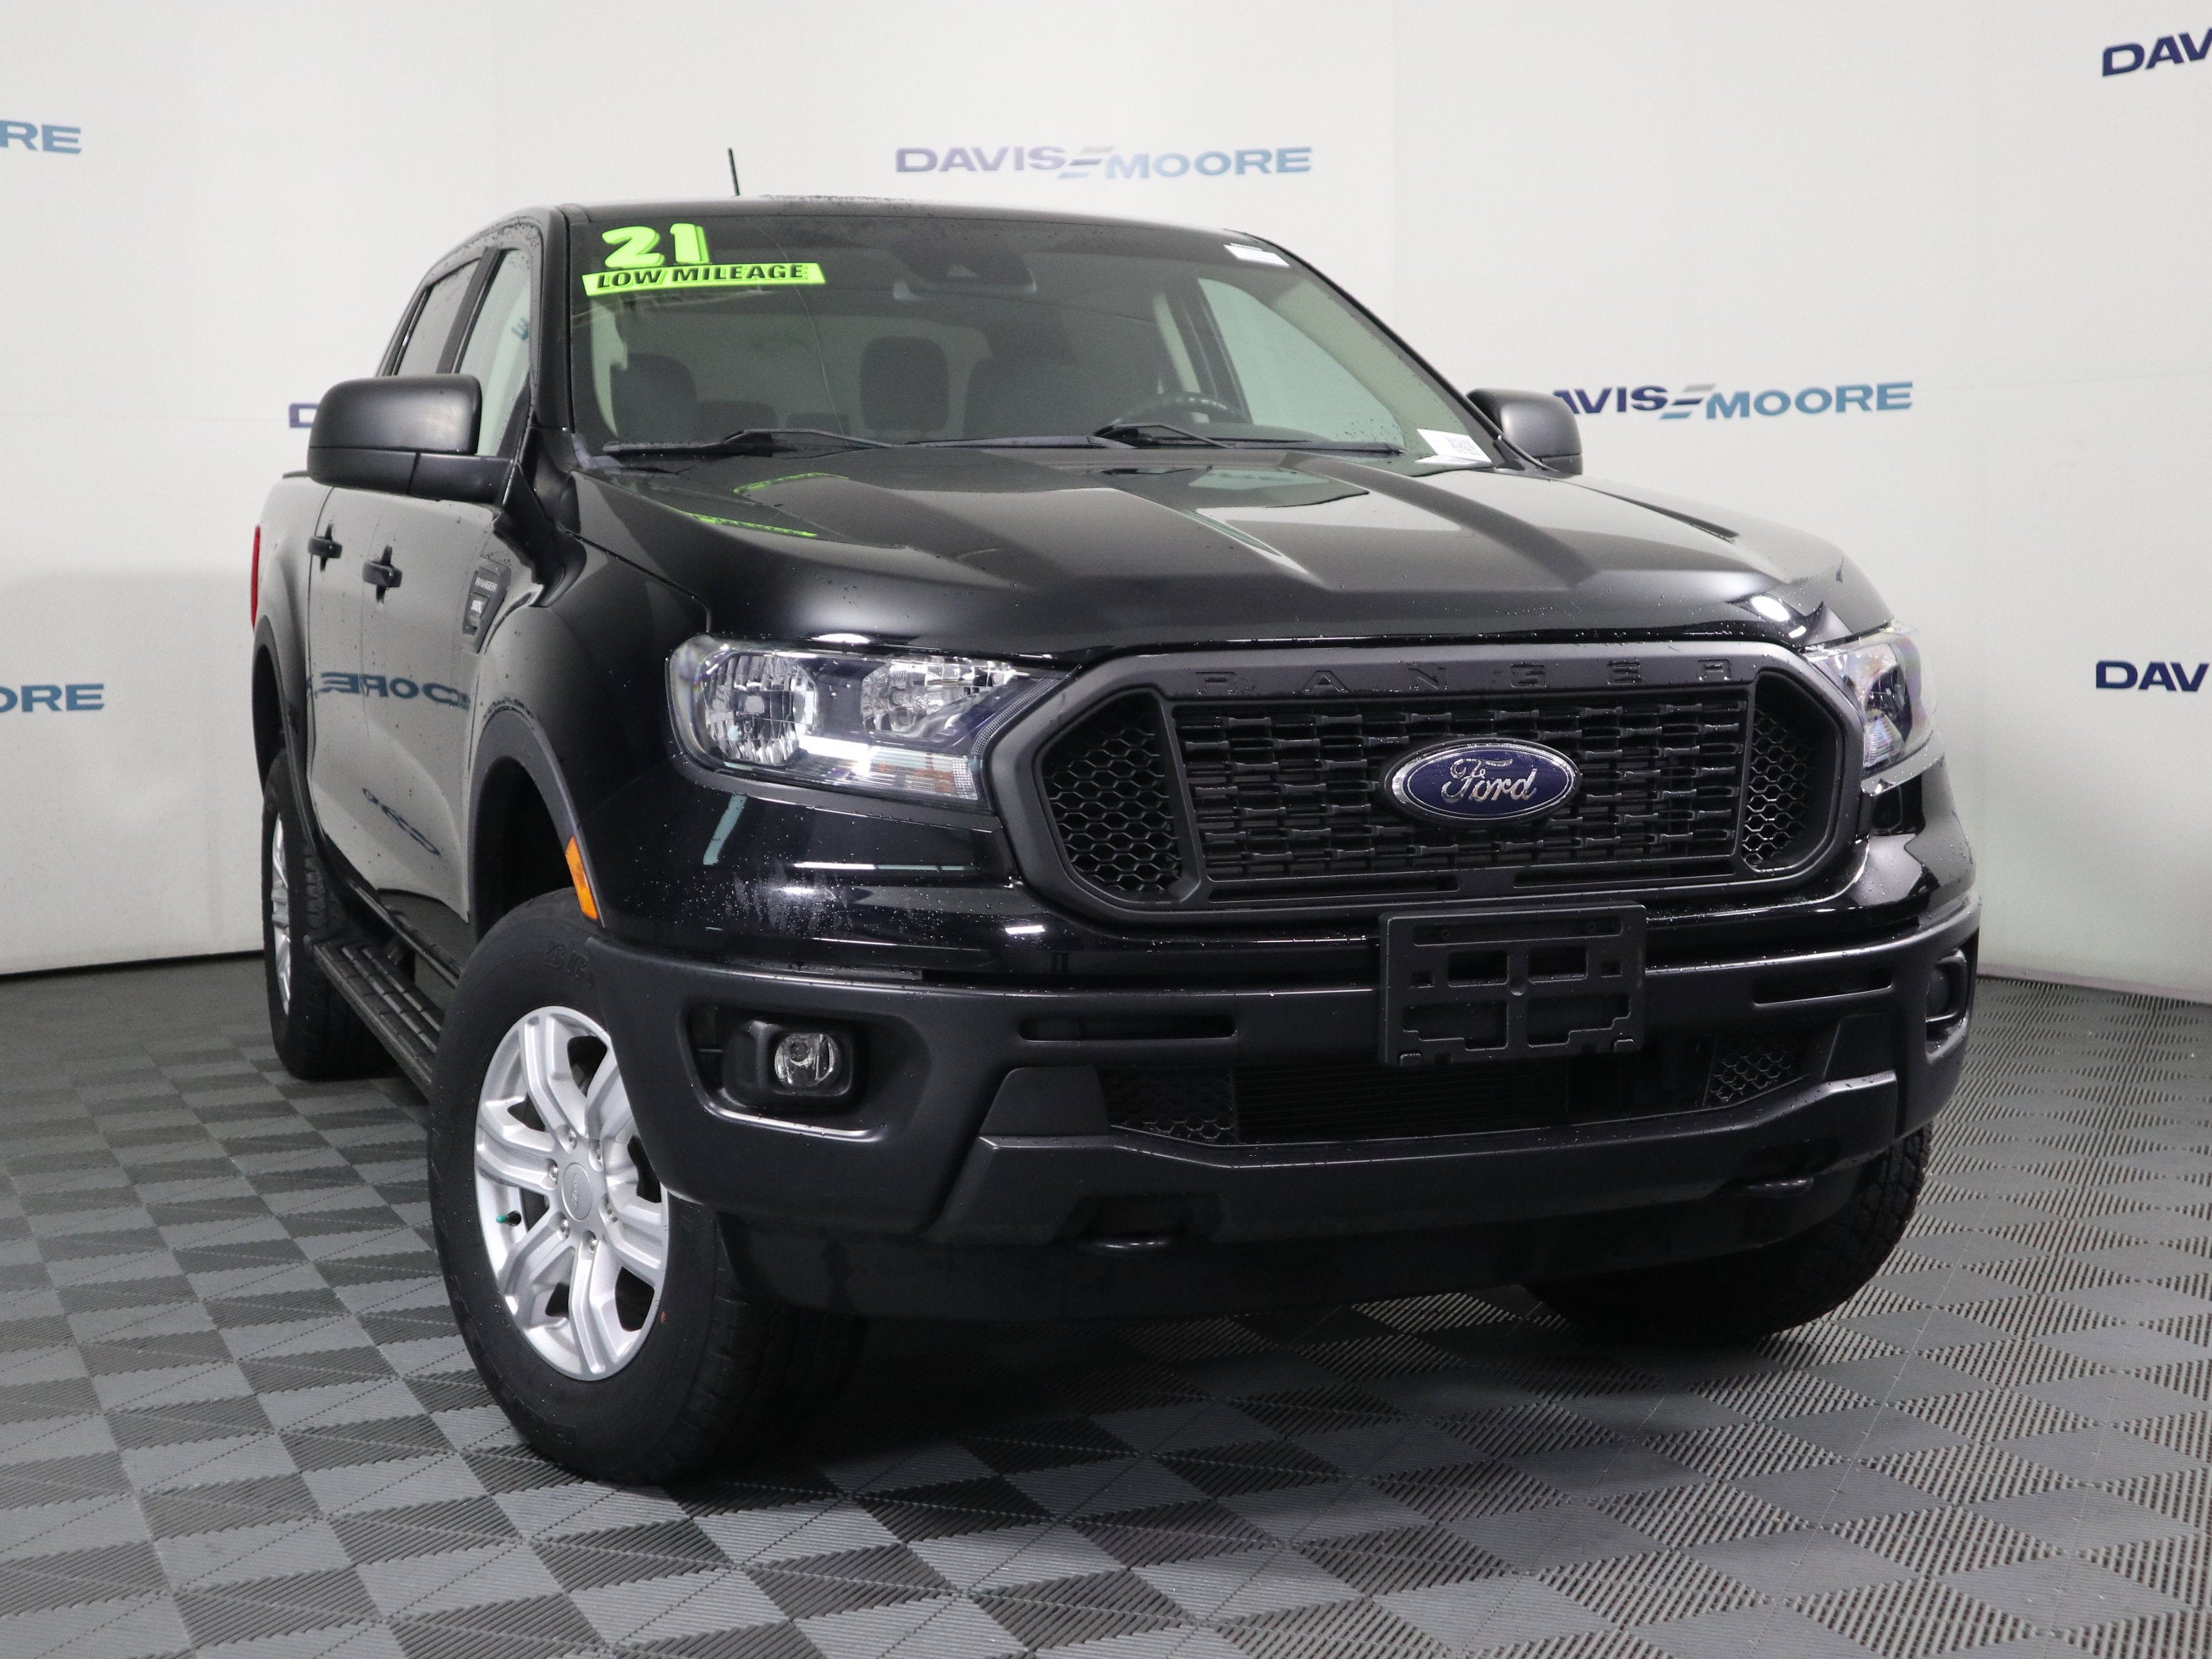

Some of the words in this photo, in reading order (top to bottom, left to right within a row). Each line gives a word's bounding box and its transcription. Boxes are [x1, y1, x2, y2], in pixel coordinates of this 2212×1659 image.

[2102, 27, 2212, 77] DAV
[896, 145, 1067, 172] DAVIS
[1104, 146, 1312, 179] MOORE
[601, 222, 710, 269] 21
[596, 269, 665, 290] LOW
[670, 263, 806, 282] MILEAGE
[1705, 381, 1913, 420] MOORE
[2095, 660, 2210, 692] DAV
[1442, 758, 1538, 804] Ford
